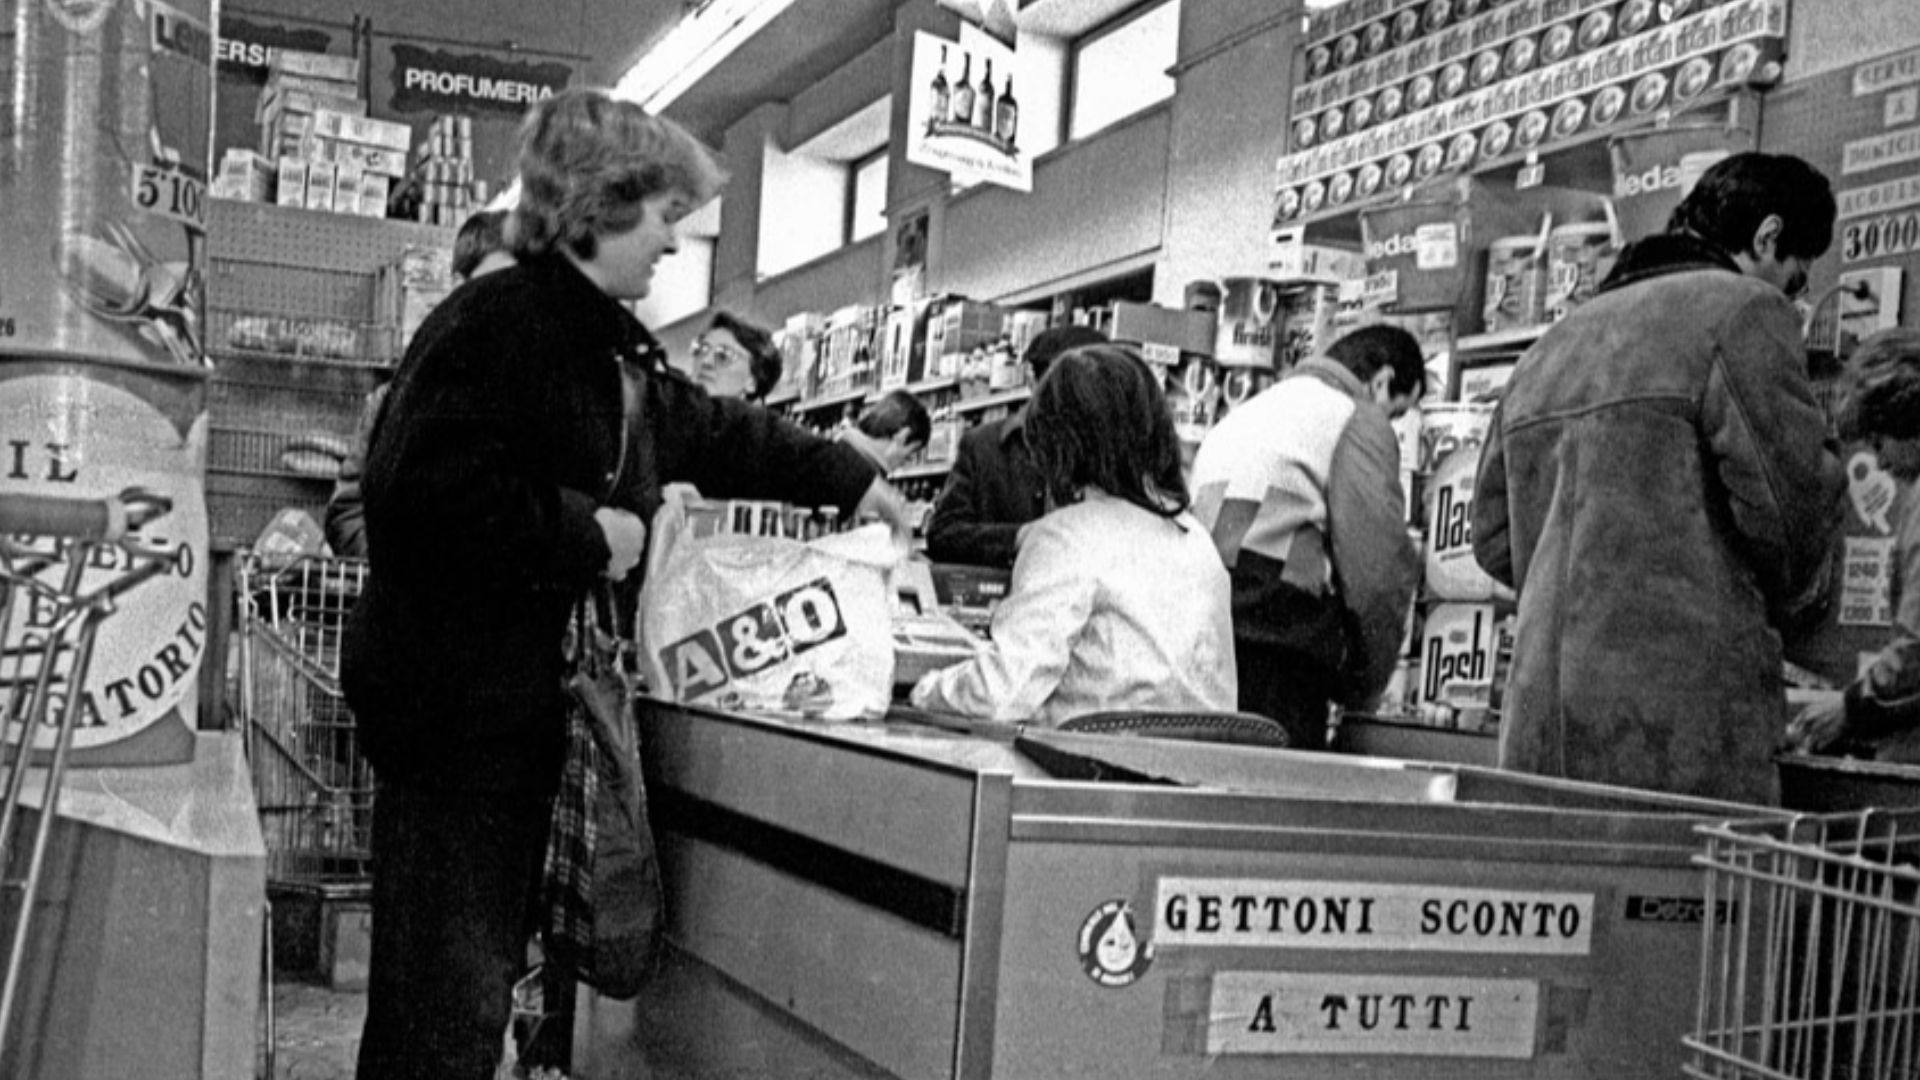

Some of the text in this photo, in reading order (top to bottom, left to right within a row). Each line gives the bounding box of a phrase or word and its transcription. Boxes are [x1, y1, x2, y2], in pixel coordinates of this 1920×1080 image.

[405, 67, 554, 103] PROFUMERIA
[674, 587, 838, 702] A&O
[1424, 610, 1485, 701] Dash
[1164, 893, 1375, 934] GETTONI
[1420, 898, 1581, 939] SCONTO
[1248, 994, 1474, 1033] A TUTTI
